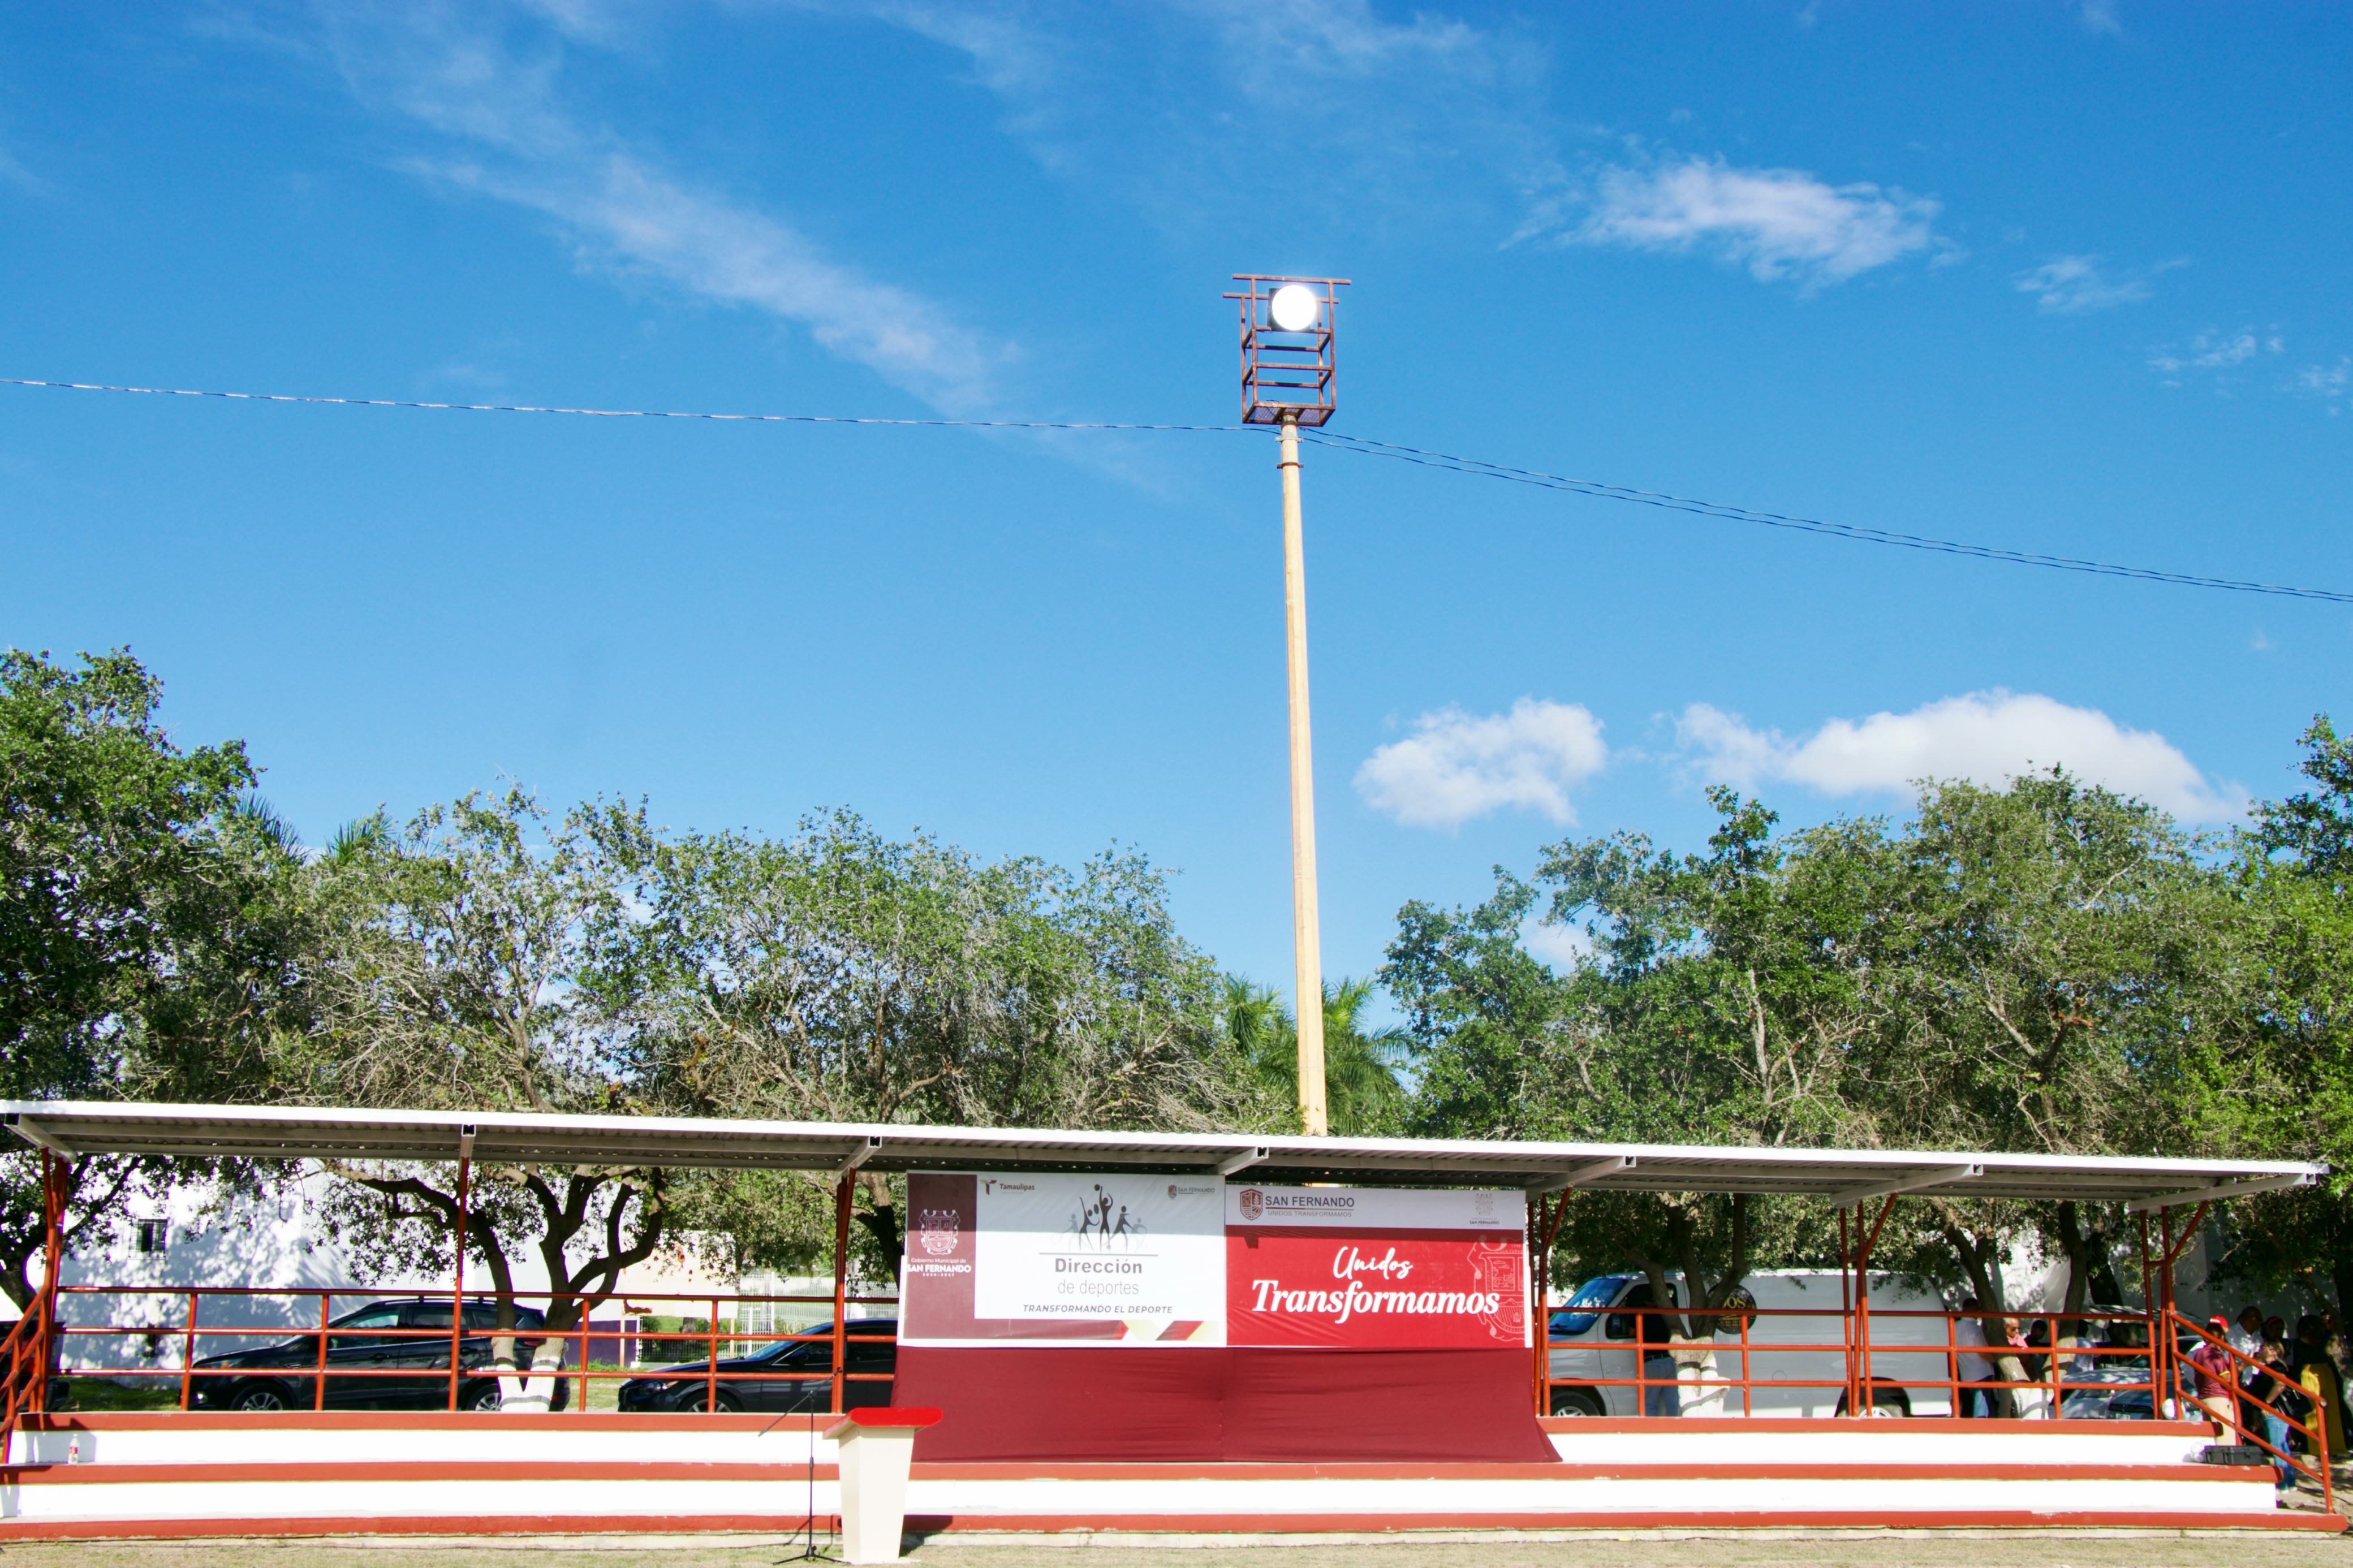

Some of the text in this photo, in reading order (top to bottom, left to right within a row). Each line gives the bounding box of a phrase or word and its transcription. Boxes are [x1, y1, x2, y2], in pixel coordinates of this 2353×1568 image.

[999, 1183, 1035, 1191] Tamaulipas
[1265, 1195, 1355, 1208] SAN FERNANDO
[906, 1264, 972, 1273] SAN FERNANDO
[1054, 1258, 1143, 1274] Dirección
[1332, 1246, 1413, 1280] Unidos
[1057, 1279, 1140, 1298] de deportes
[1023, 1304, 1111, 1313] TRANSFORMANDO
[1252, 1279, 1500, 1324] Transformamos
